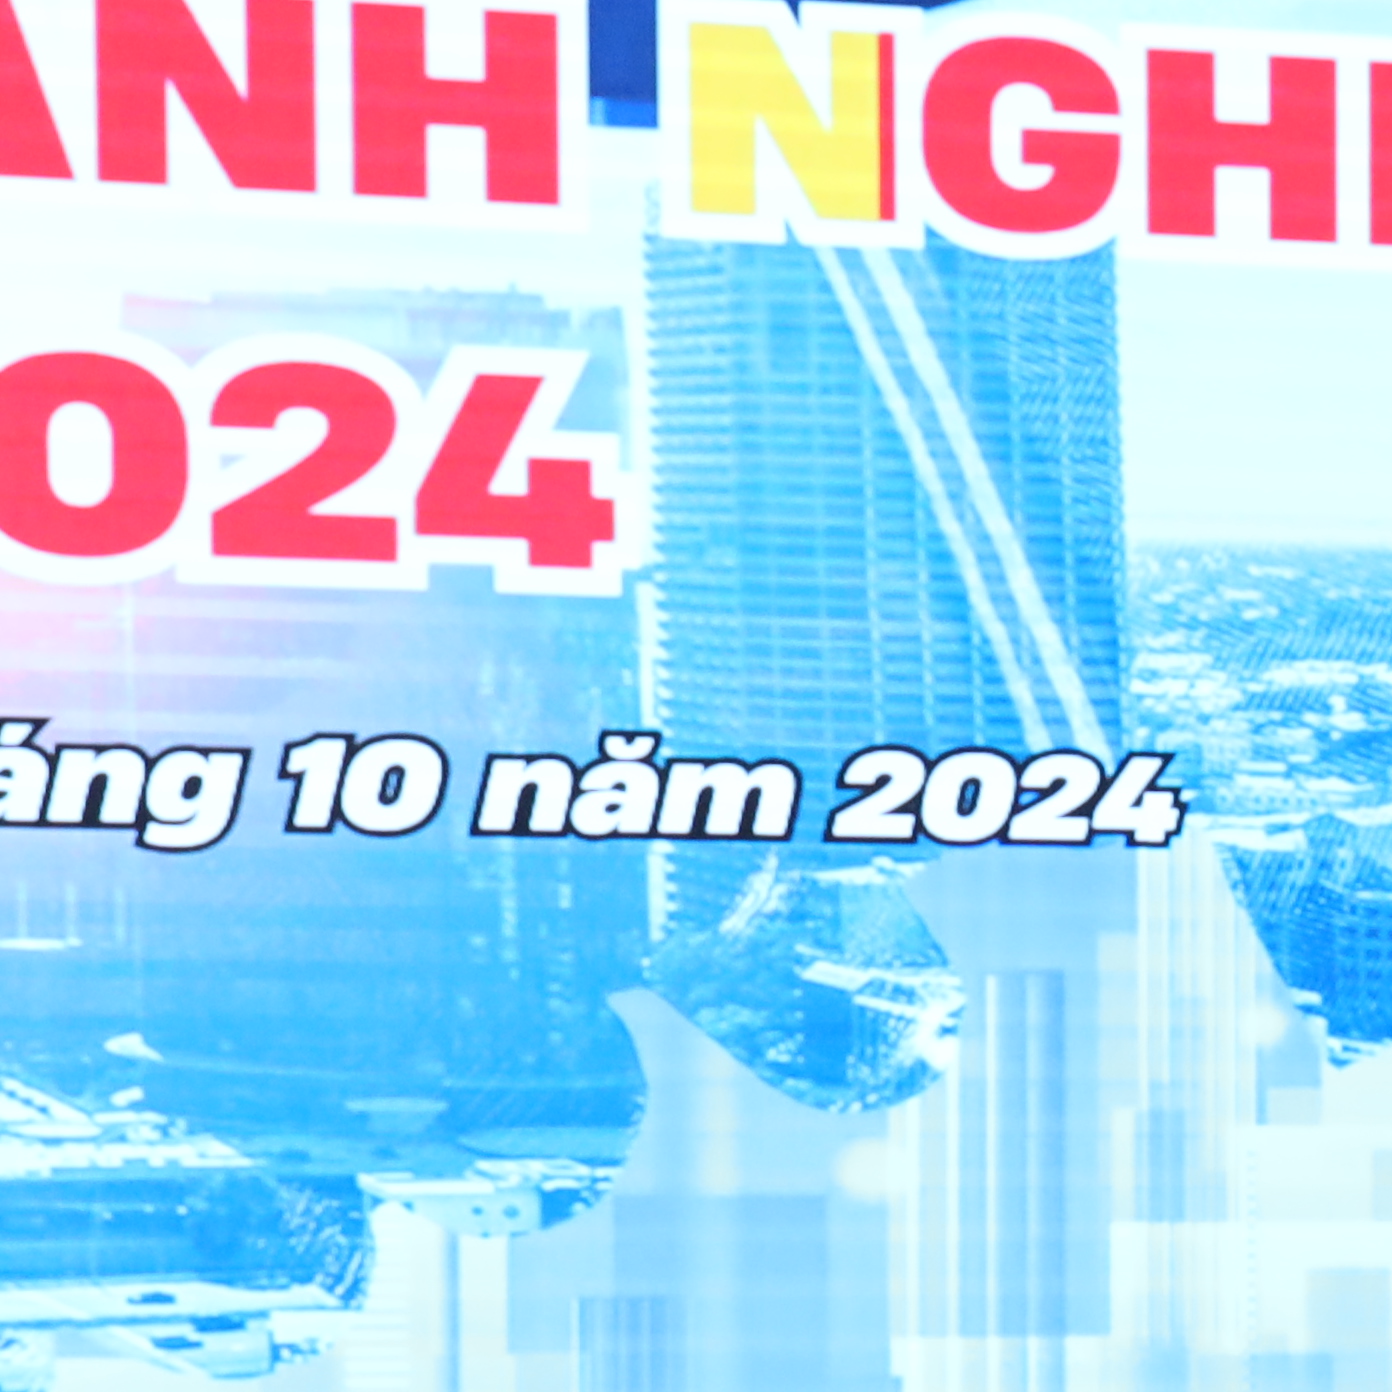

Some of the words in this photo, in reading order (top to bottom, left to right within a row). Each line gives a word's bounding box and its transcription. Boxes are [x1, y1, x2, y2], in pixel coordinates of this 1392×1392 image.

[279, 734, 448, 836] 10
[471, 731, 801, 840] năm
[825, 746, 1186, 846] 2024
